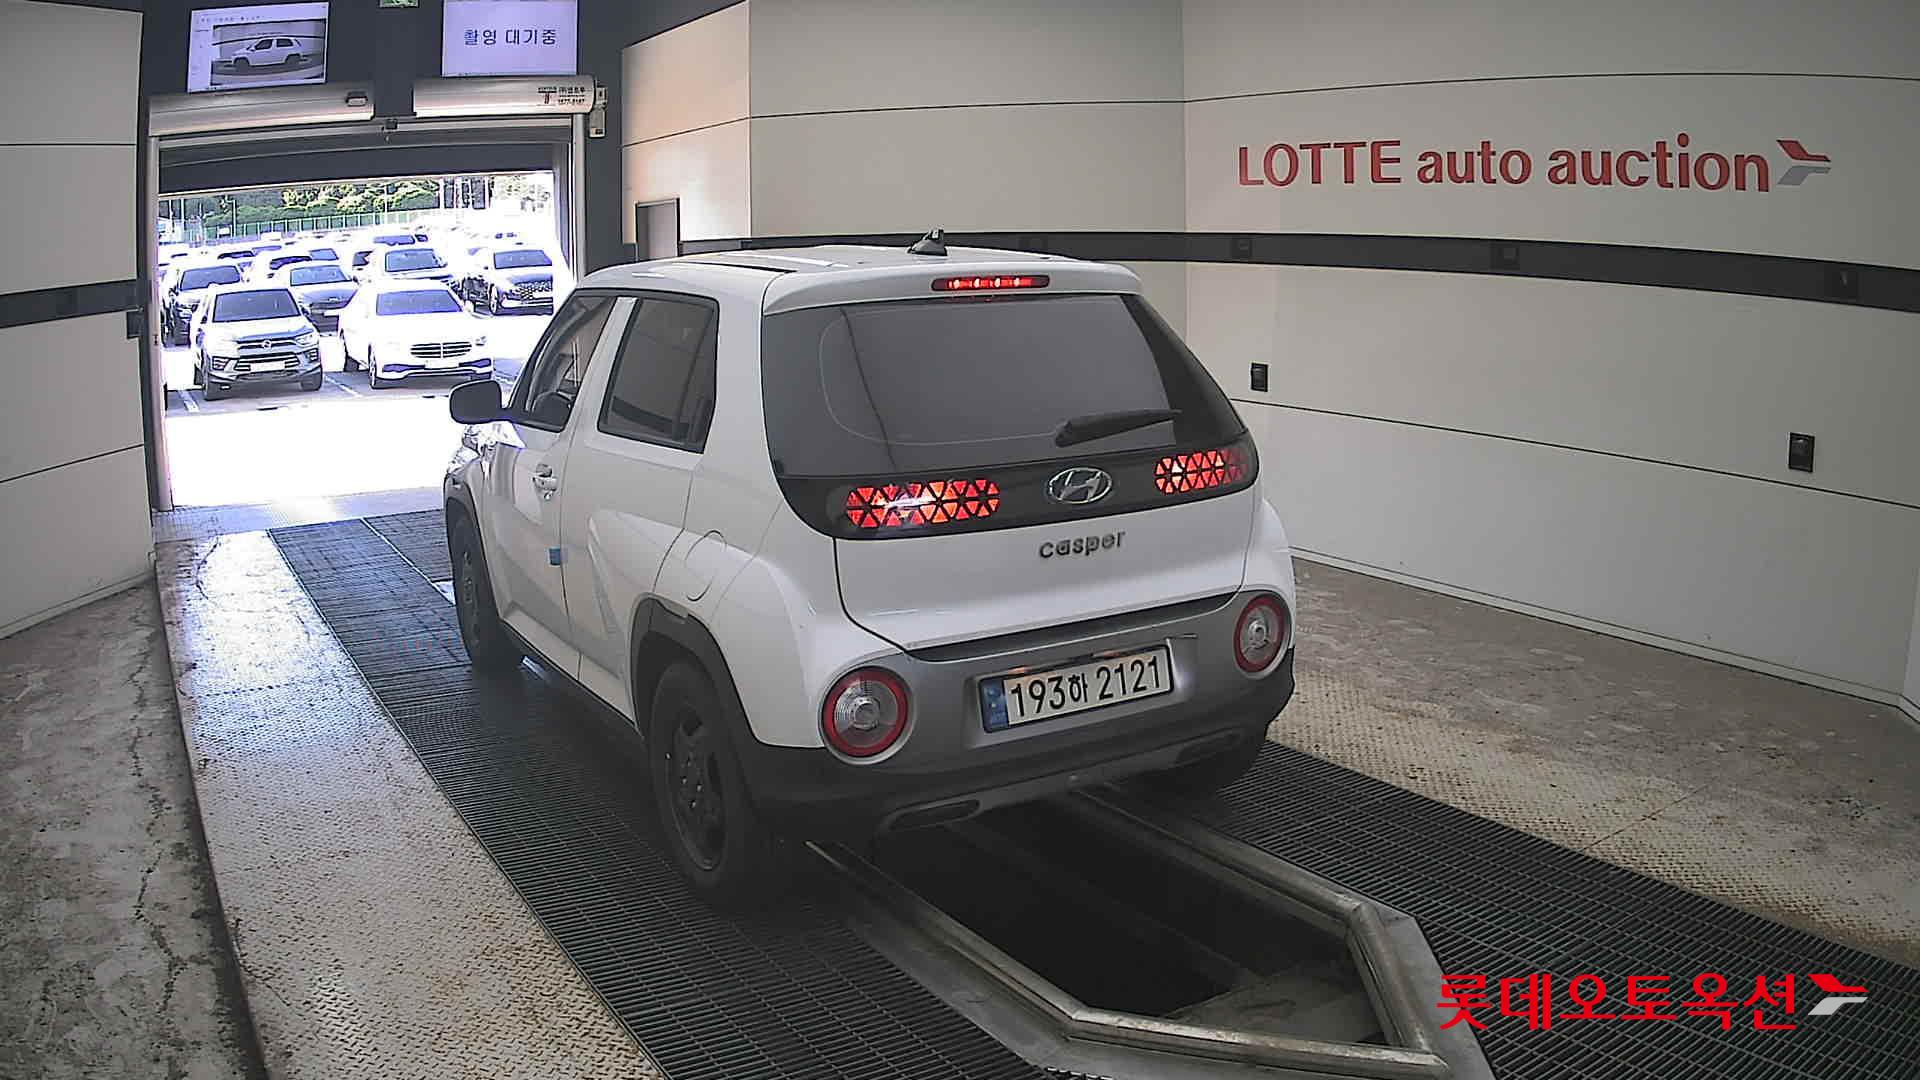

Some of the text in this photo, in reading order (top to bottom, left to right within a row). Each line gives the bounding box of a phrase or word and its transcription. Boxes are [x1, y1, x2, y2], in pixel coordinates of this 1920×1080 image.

[464, 29, 557, 46] 촬영 대기중
[1239, 133, 1769, 192] LOTTE auto auction
[1040, 531, 1126, 558] casper
[1010, 655, 1160, 717] 193하 2121
